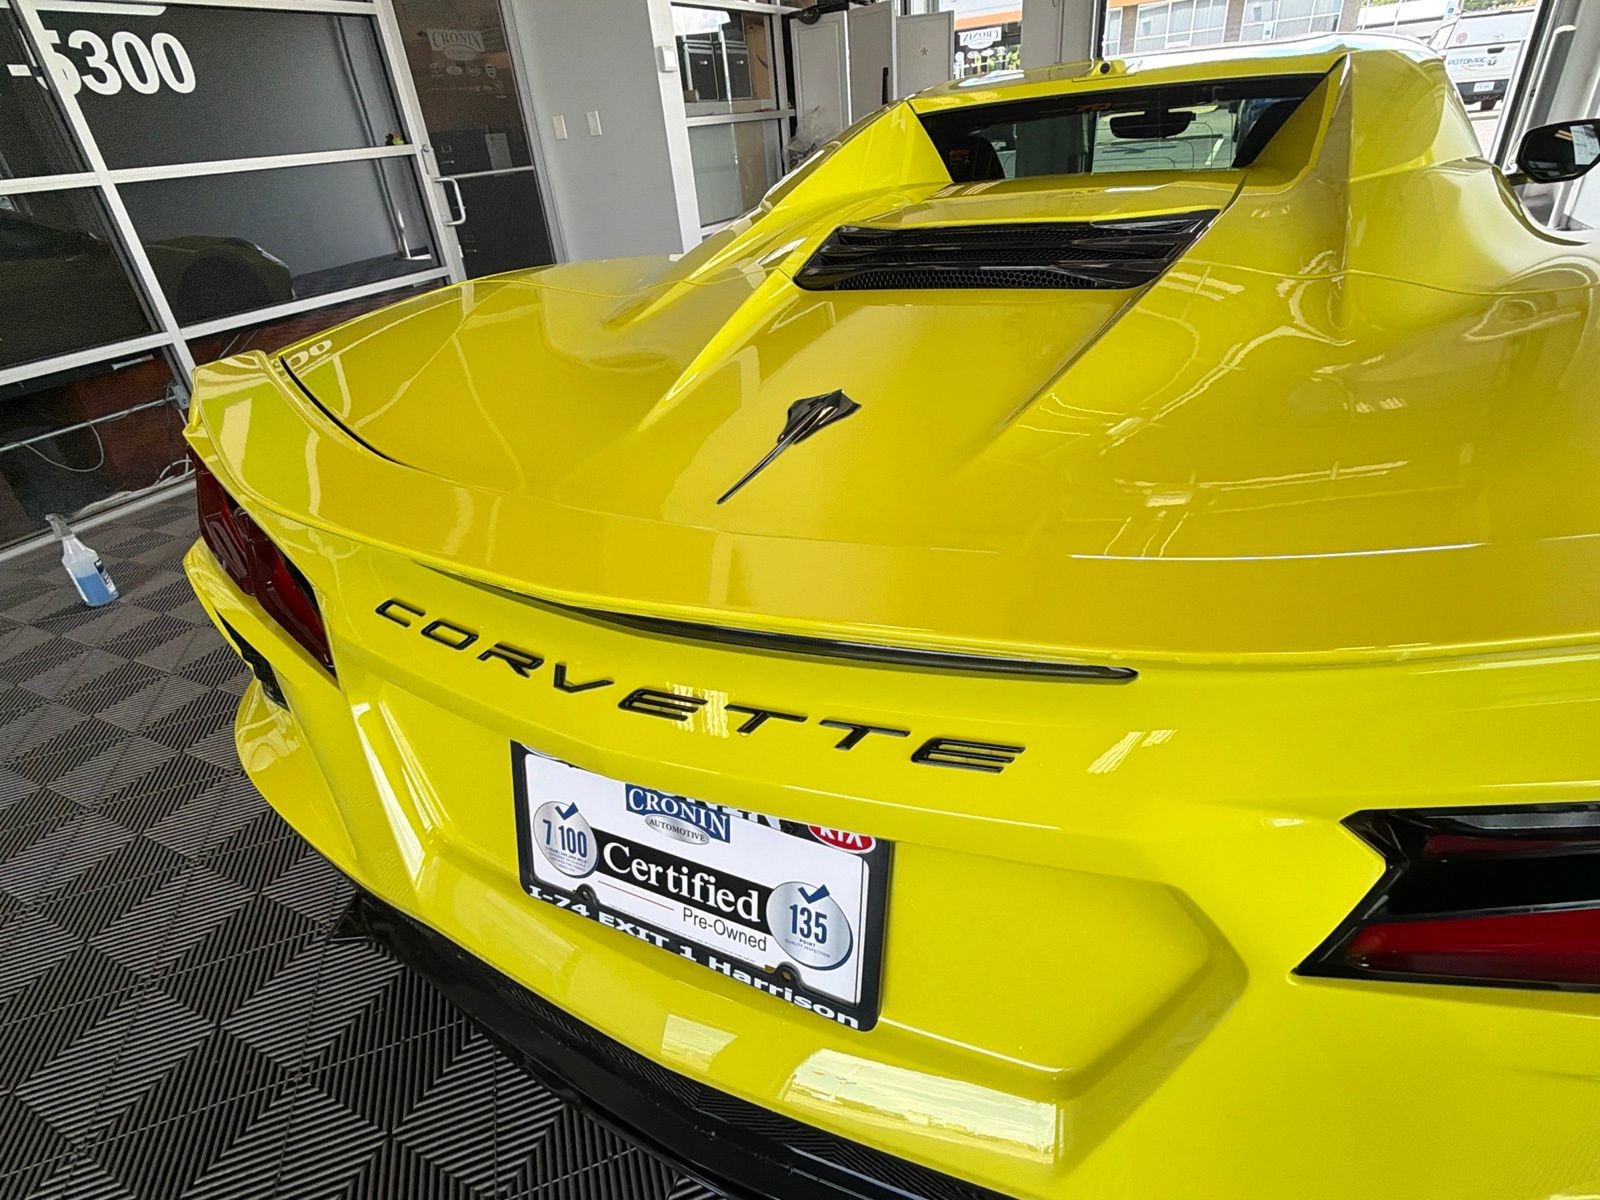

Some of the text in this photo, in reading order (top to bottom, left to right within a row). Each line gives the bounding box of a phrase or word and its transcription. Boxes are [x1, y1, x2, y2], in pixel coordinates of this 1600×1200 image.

[432, 31, 482, 49] CRONIN
[374, 597, 1027, 774] CORVETTE
[628, 788, 728, 840] CRONIN
[649, 818, 706, 843] AUTOMOTIVE
[558, 825, 588, 858] 100
[603, 842, 761, 922] Certified
[683, 907, 768, 952] Pre-Owned
[789, 904, 828, 944] 135
[529, 885, 590, 917] I-74
[599, 911, 670, 948] EXIT
[679, 945, 697, 962] 1
[708, 956, 860, 1030] Harrison
